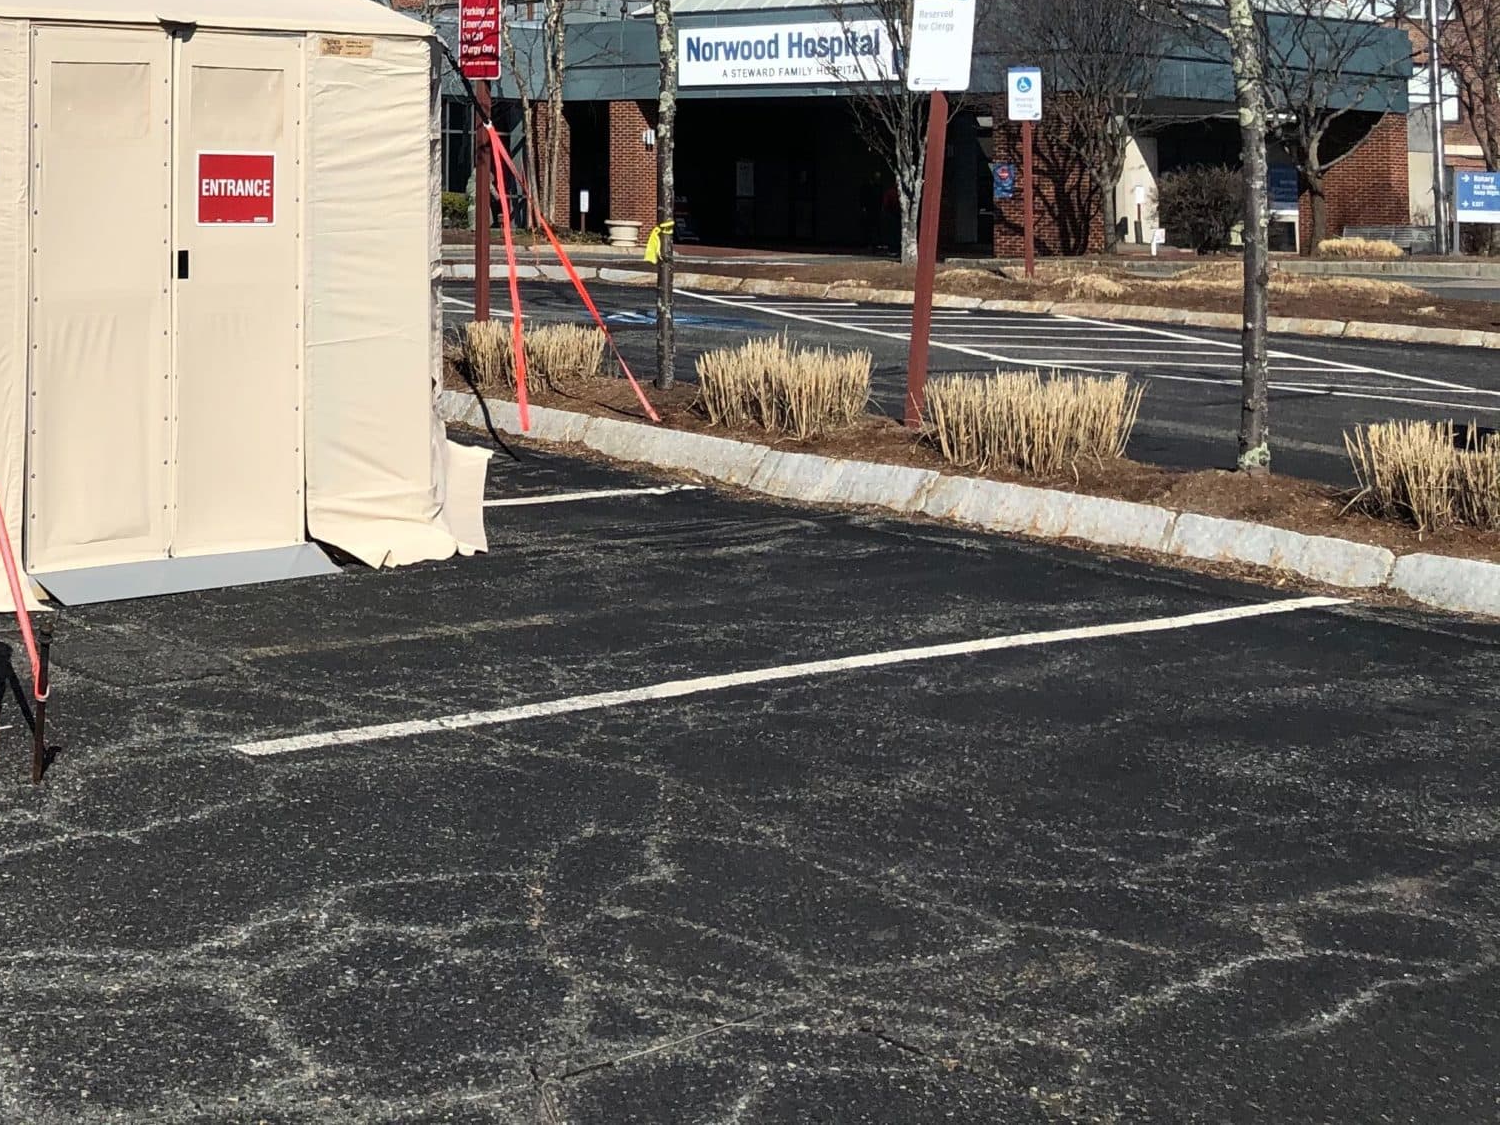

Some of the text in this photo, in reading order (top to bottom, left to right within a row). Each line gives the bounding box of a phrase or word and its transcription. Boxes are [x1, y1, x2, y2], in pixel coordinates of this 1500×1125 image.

[462, 7, 485, 17] Parking
[919, 9, 954, 18] Reserved
[462, 20, 495, 29] Emergency
[918, 22, 955, 32] for Clergy
[686, 27, 880, 63] Norwood Hospital
[722, 65, 860, 78] A STEWARD FAMILY HOSPITA
[1473, 175, 1494, 183] Rotary
[202, 178, 271, 197] ENTRANCE
